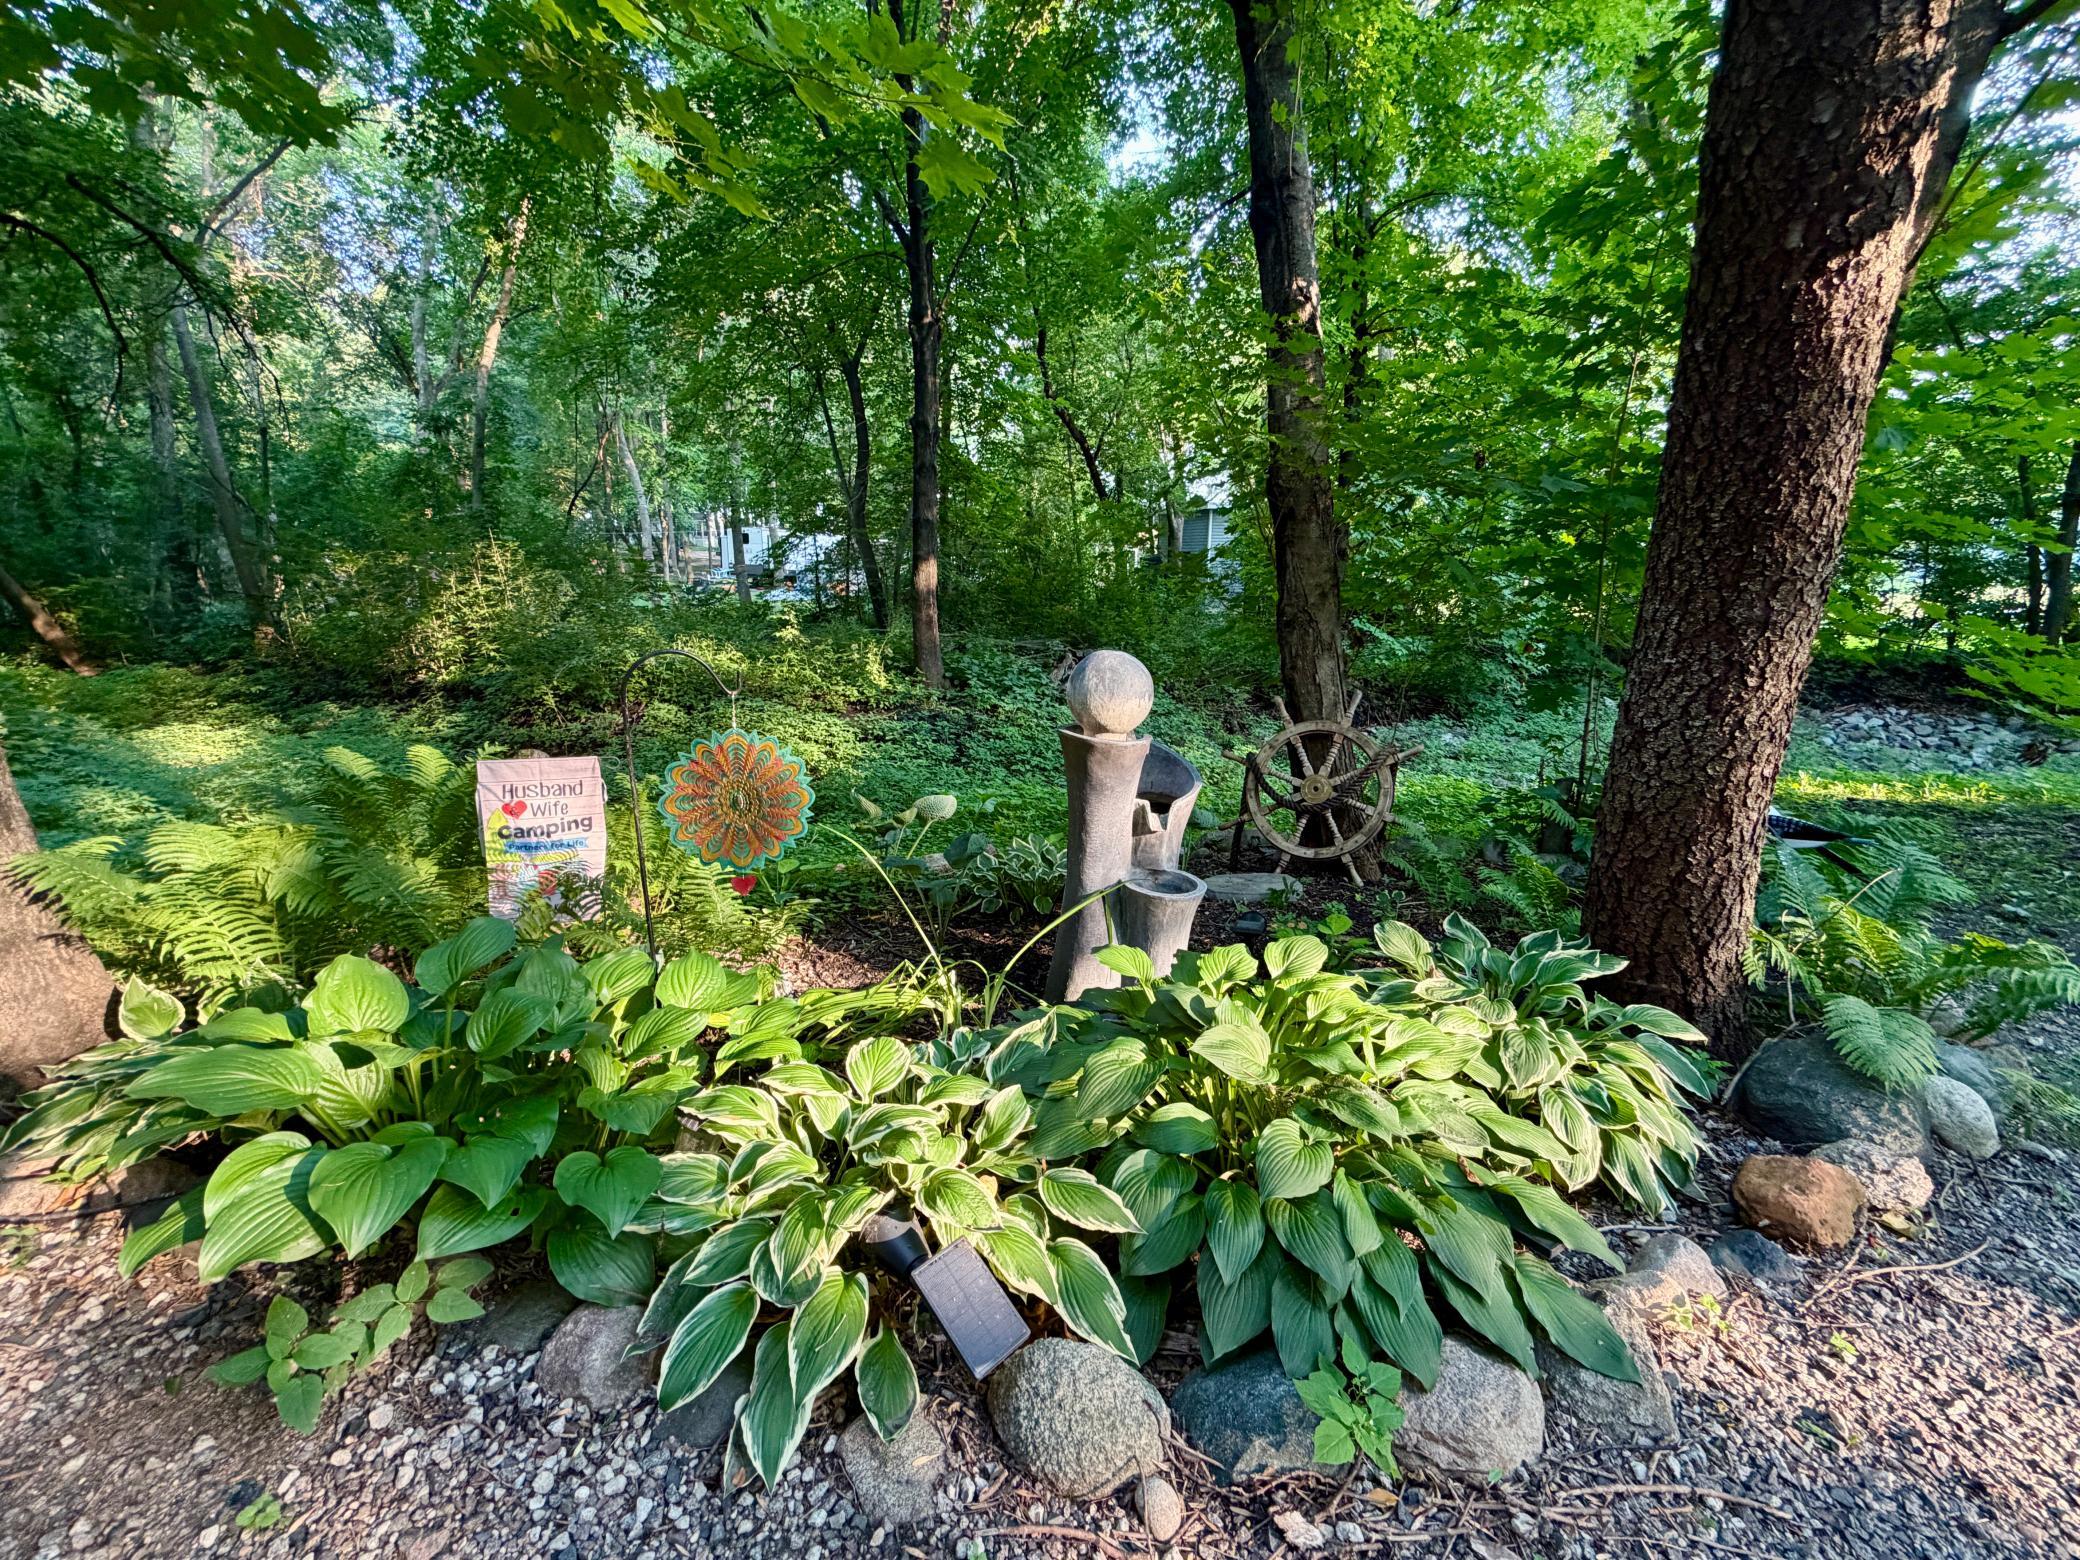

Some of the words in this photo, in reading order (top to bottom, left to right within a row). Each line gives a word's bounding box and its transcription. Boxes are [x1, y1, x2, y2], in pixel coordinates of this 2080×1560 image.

[502, 779, 583, 800] Husband
[530, 800, 569, 817] Wife
[497, 816, 593, 839] Camping
